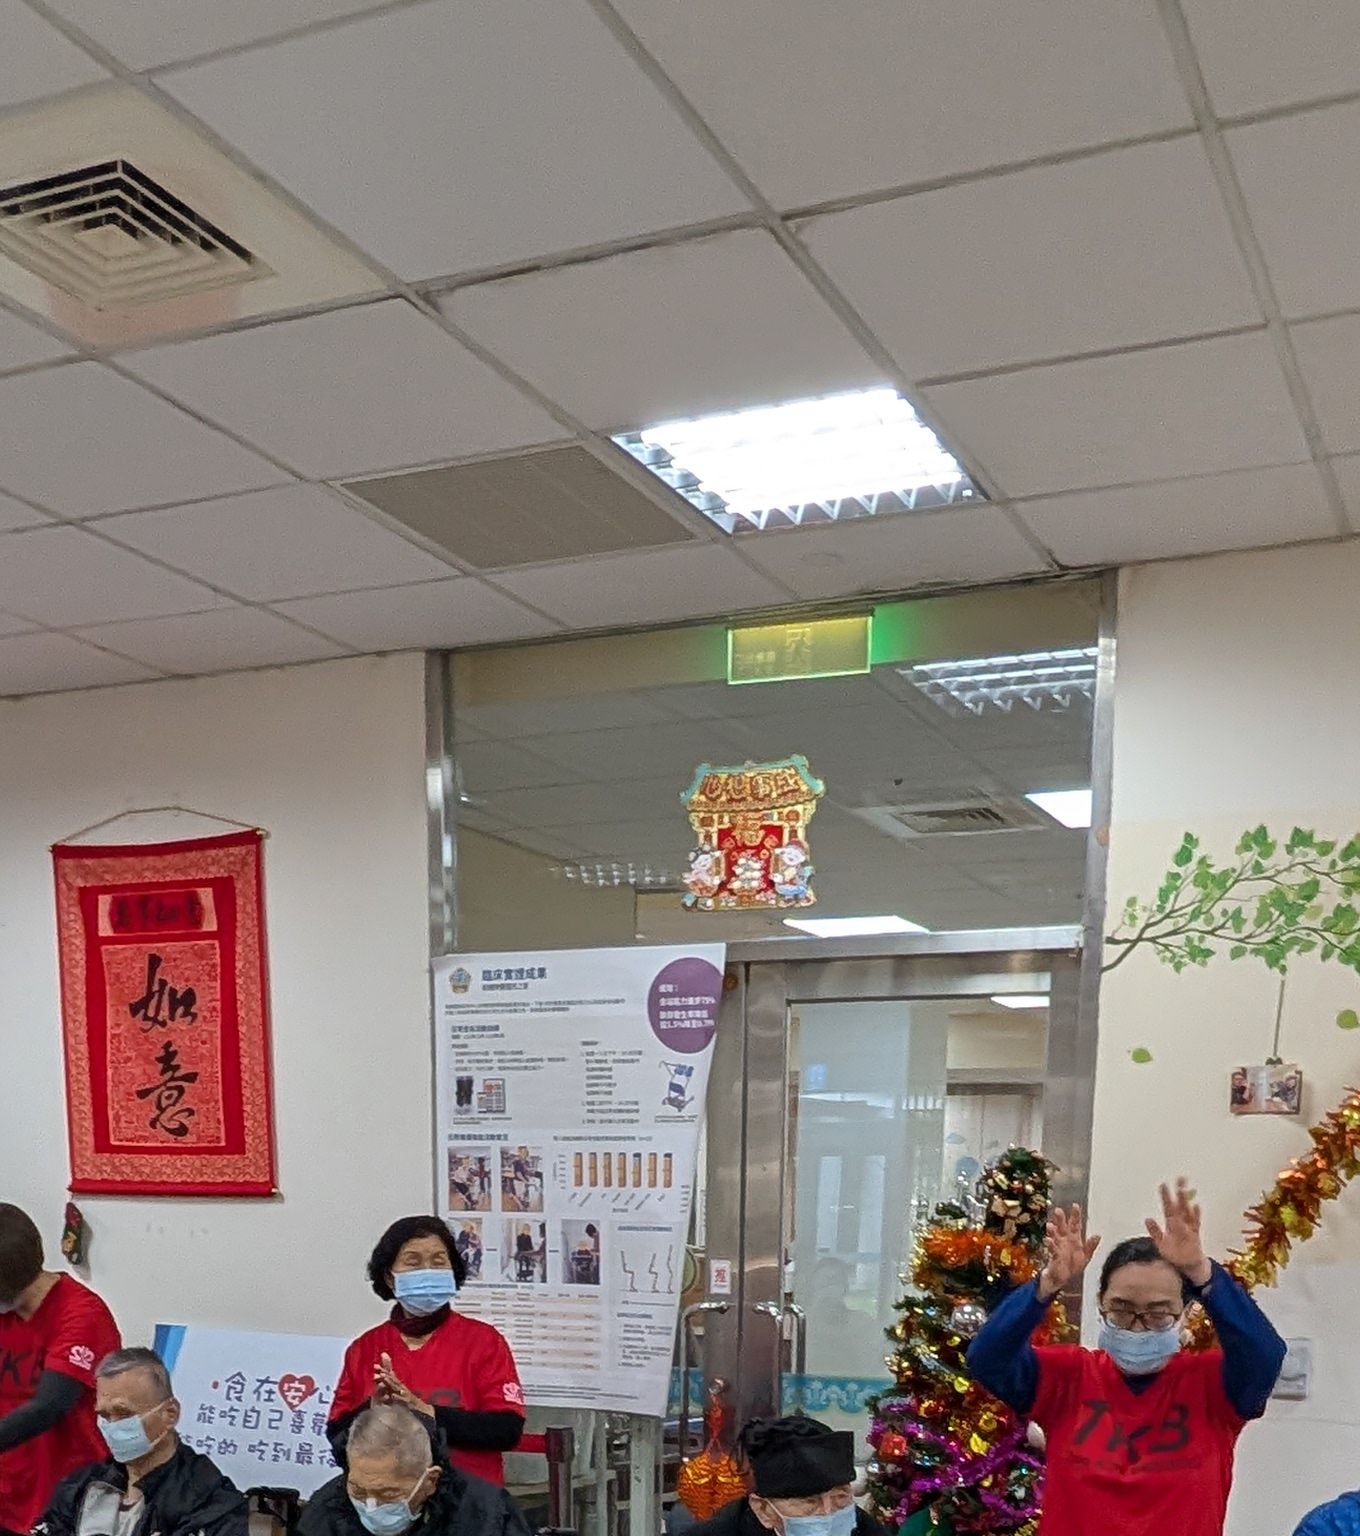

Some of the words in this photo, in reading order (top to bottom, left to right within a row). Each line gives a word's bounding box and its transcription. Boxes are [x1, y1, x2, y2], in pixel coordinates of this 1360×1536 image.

[128, 953, 198, 1138] 如意
[224, 1371, 332, 1405] 食在安心
[1073, 1399, 1191, 1463] TKB
